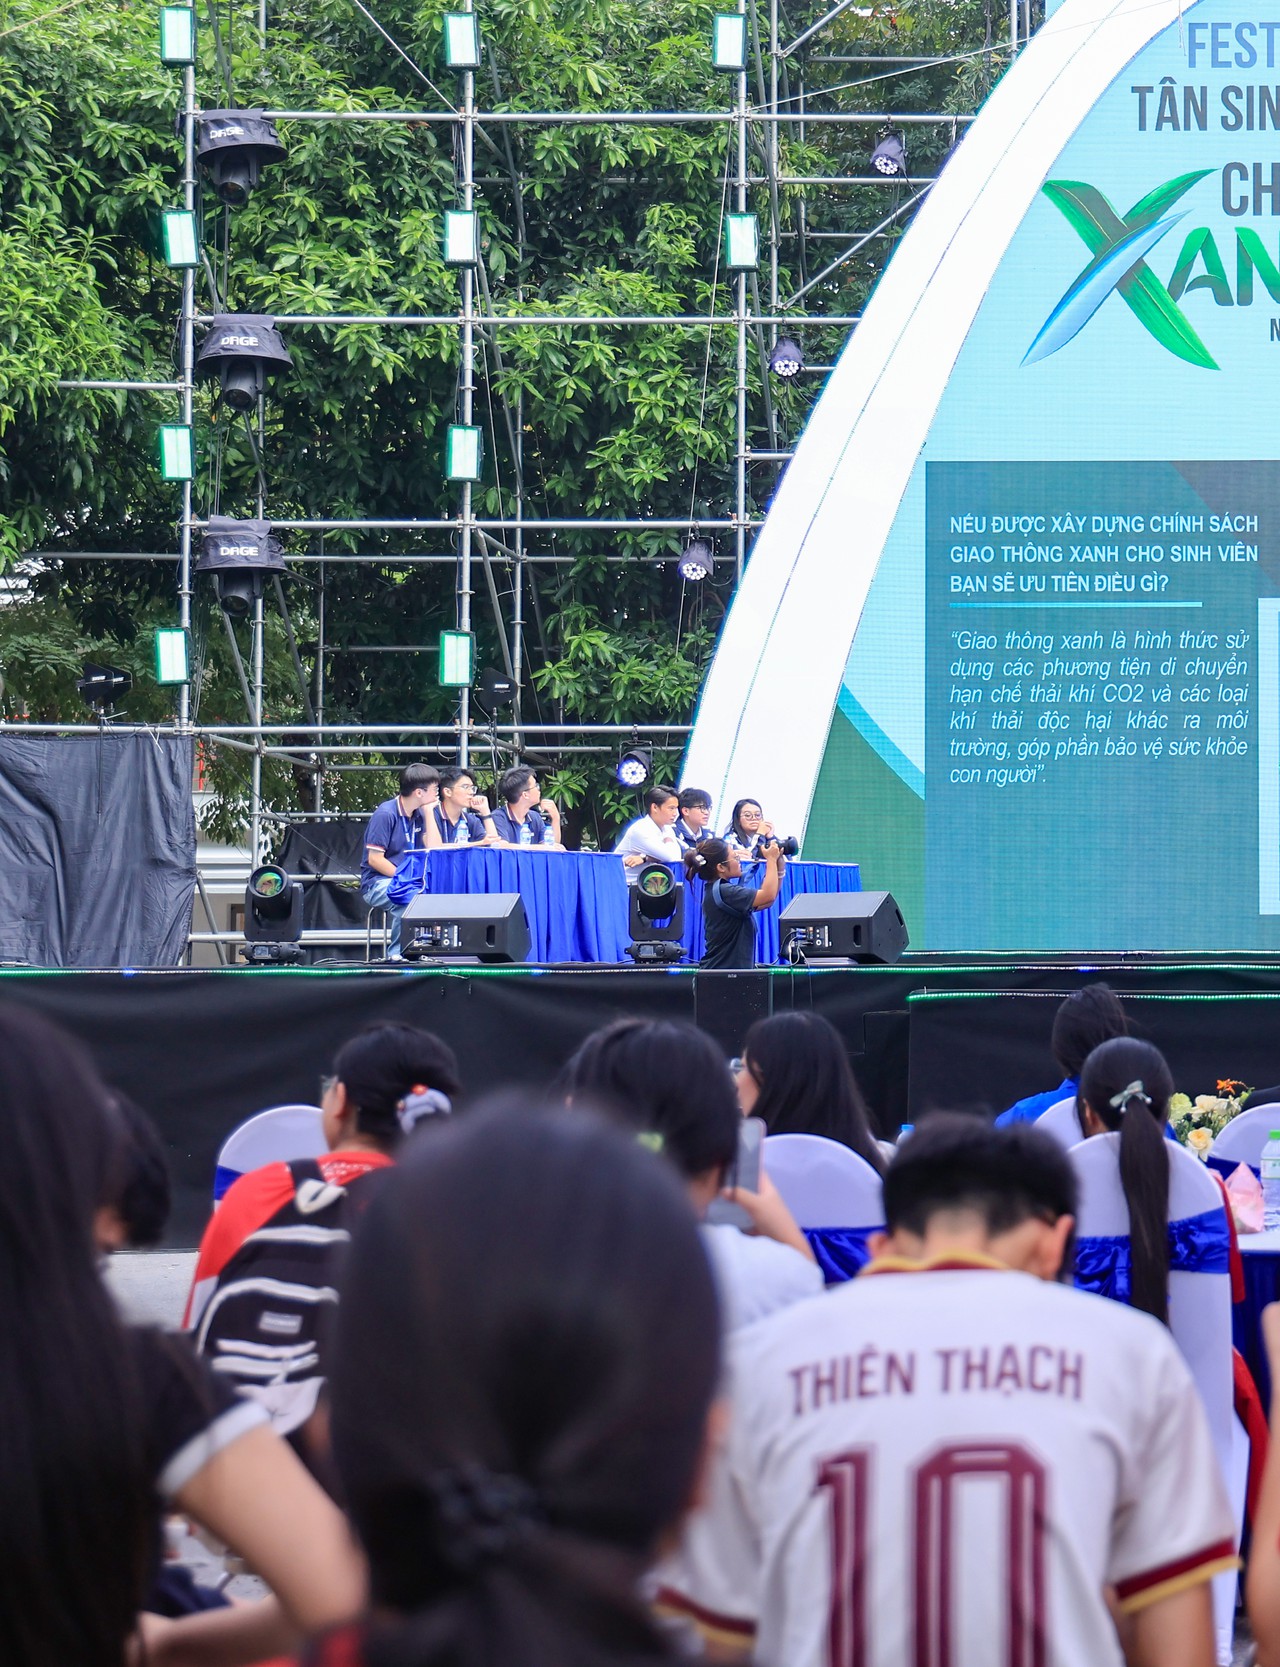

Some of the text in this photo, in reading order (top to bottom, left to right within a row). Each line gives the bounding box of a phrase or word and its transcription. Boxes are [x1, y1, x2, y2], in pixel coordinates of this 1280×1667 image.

[1131, 77, 1207, 131] TÂN
[991, 516, 1046, 537] ĐƯỢC
[1050, 511, 1087, 533] XÂY
[1091, 515, 1145, 537] DỰNG
[1149, 511, 1204, 533] CHÍNH
[1209, 511, 1258, 533] SÁCH
[220, 546, 259, 557] DAGE
[950, 540, 1258, 563] GIAO THÔNG XANH CHO SINH VIÊN
[950, 570, 1169, 597] BẠN SẼ ƯU TIÊN ĐIỀU GÌ?
[1005, 630, 1054, 654] thông
[1060, 630, 1104, 650] xanh
[1110, 630, 1127, 649] là
[1133, 630, 1172, 649] hình
[1179, 630, 1219, 649] thức
[1225, 629, 1250, 649] sử
[950, 652, 1248, 681] dụng các phương tiện di chuyển
[949, 680, 1249, 706] hạn chế thải khí CO2 và các loại
[949, 709, 1249, 733] khí thải độc hại khác ra môi
[950, 733, 1248, 761] trường, góp phần bảo vệ sức khỏe
[949, 768, 981, 784] con
[789, 1344, 1084, 1417] THIÊN THẠCH
[816, 1438, 1048, 1667] 10
